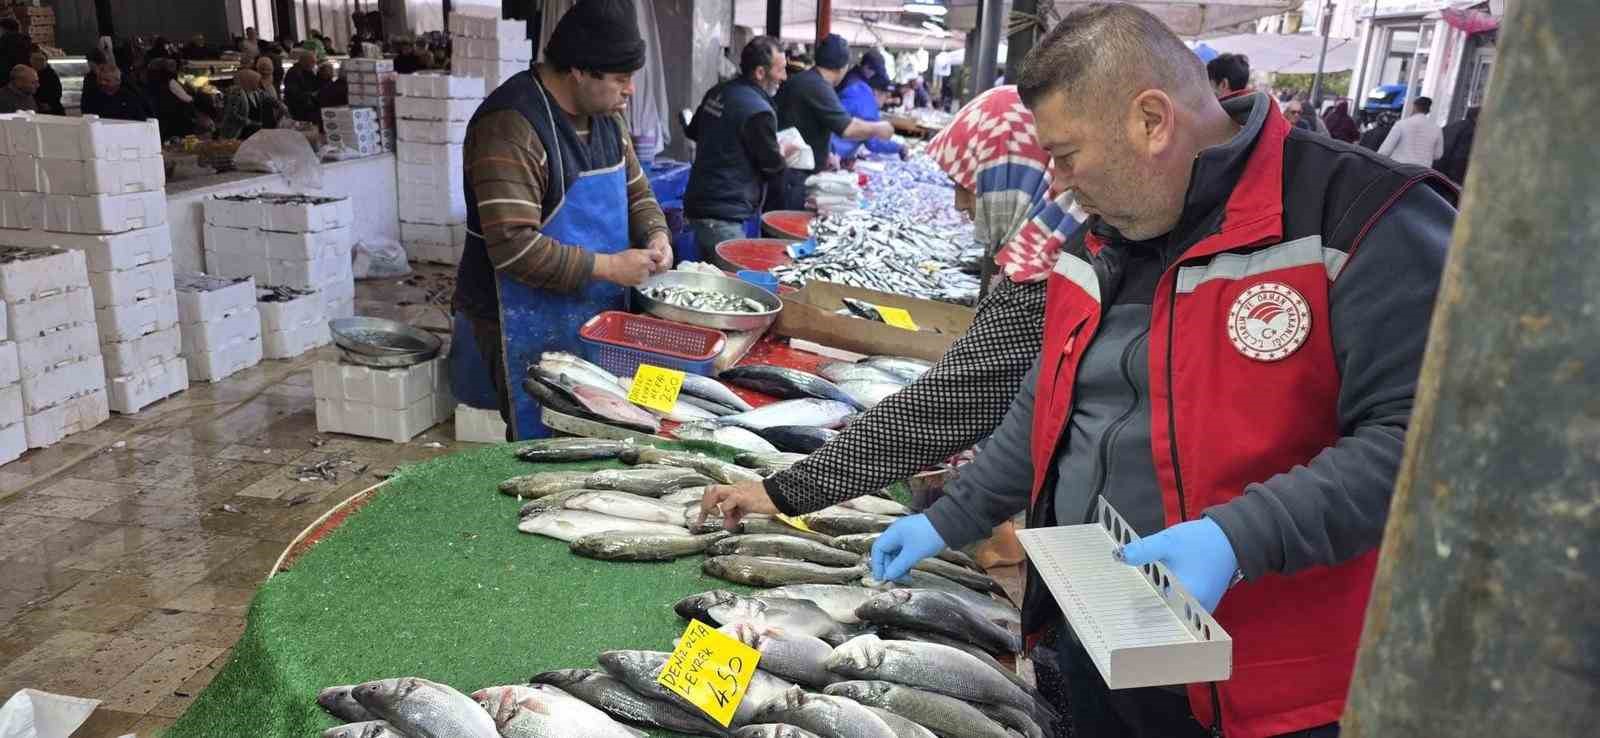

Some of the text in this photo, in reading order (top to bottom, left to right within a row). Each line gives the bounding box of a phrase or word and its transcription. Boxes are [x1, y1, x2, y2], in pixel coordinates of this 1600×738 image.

[1239, 316, 1250, 340] TARIM
[1257, 293, 1287, 305] ORMAN
[686, 625, 710, 649] OLTA
[679, 648, 713, 694] LEVREK
[707, 657, 742, 708] 450
